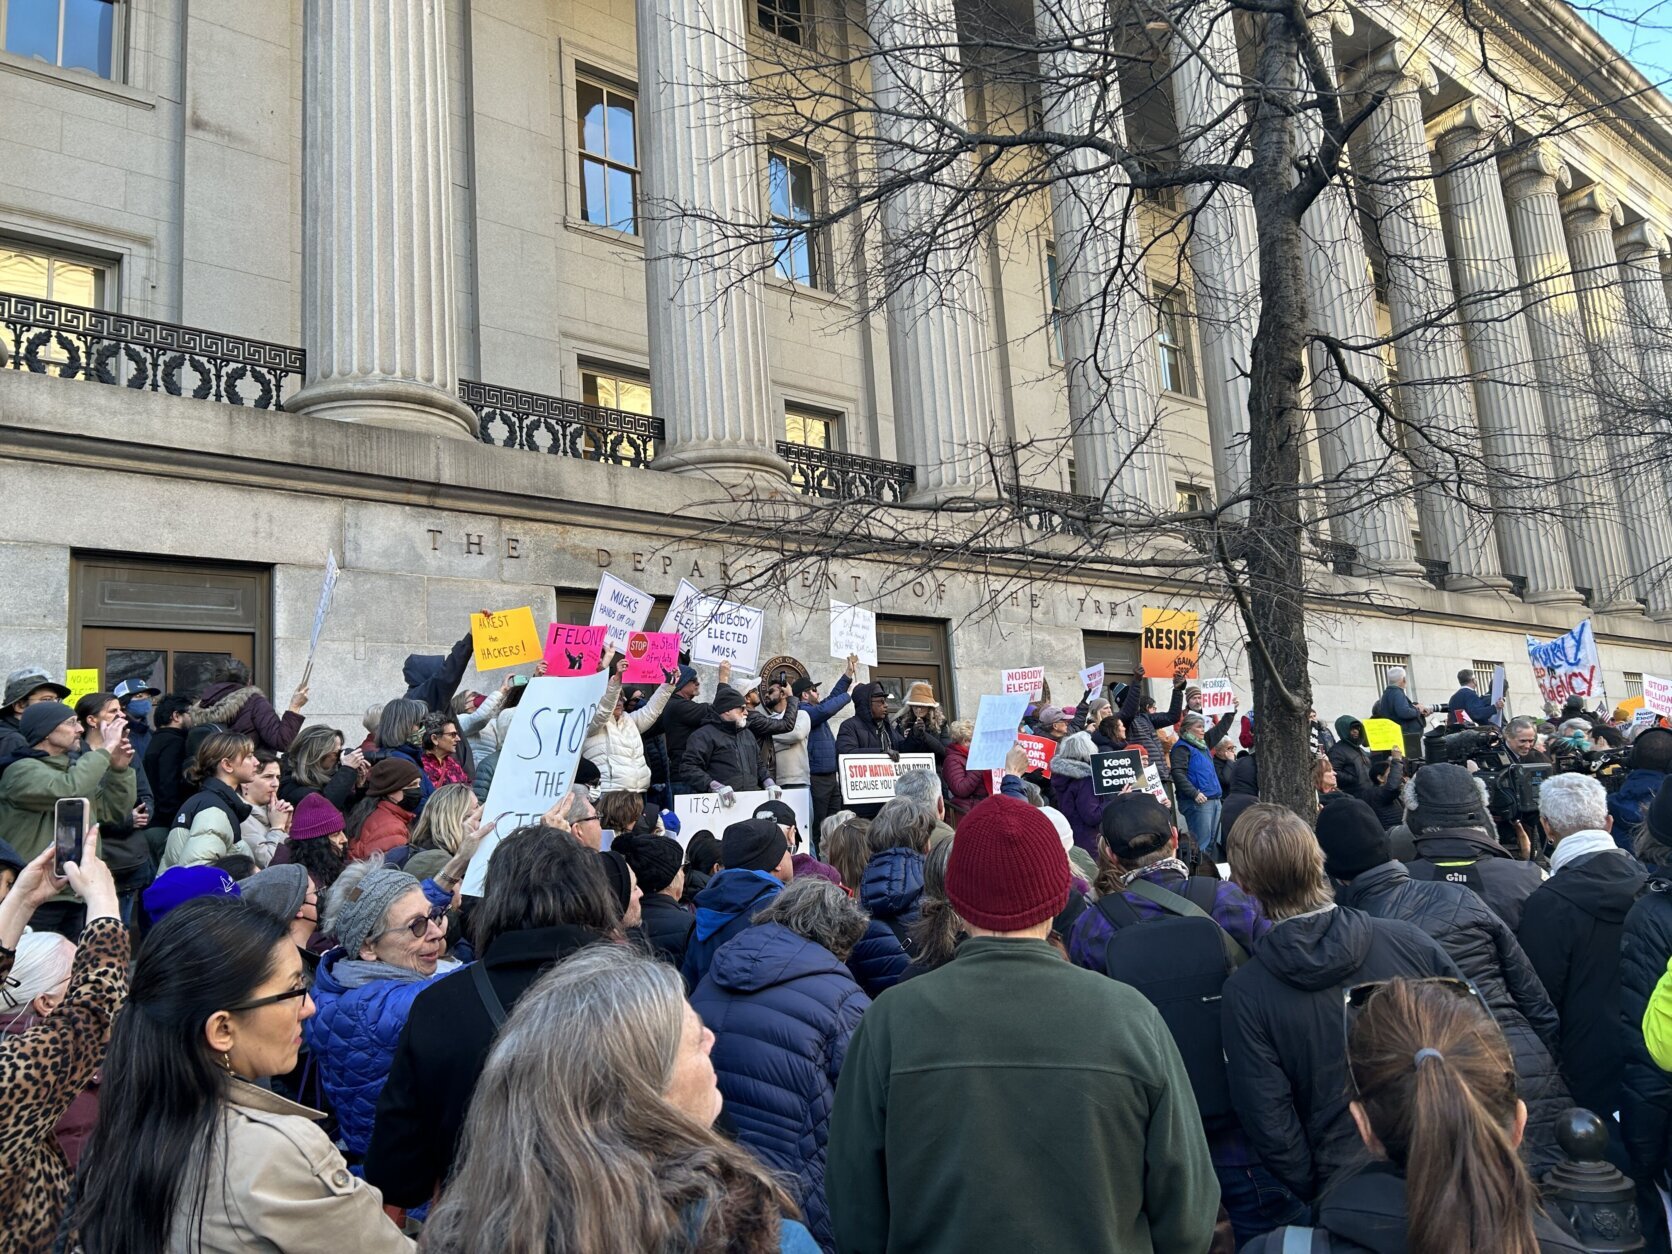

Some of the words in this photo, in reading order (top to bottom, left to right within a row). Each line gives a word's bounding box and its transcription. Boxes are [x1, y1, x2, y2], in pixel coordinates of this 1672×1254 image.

[426, 529, 521, 559] THE
[912, 581, 946, 600] OF
[990, 589, 1040, 609] THE
[610, 590, 639, 613] MUSK'S
[599, 603, 616, 619] HANDS
[479, 615, 509, 629] ARREST
[710, 612, 751, 629] NOBODY
[553, 627, 605, 646] FELON!
[707, 628, 748, 644] ELECTED
[1144, 627, 1195, 652] RESIST
[481, 640, 527, 660] HACKERS!
[630, 640, 647, 651] STOP
[711, 645, 737, 659] MUSK
[1007, 670, 1041, 681] NOBODY
[1006, 681, 1042, 693] ELECTED
[1648, 681, 1669, 692] STOP
[1202, 692, 1232, 708] FIGHT
[1648, 700, 1672, 715] TAKEO
[1022, 741, 1044, 750] STOP
[1103, 758, 1132, 768] Keep
[849, 765, 868, 779] STOP
[869, 764, 895, 778] HATING
[894, 764, 912, 776] EACH
[1102, 767, 1135, 777] Going,
[534, 771, 566, 798] THE
[850, 780, 880, 791] BECAUSE
[880, 779, 892, 790] YOU
[690, 797, 710, 814] IT'S
[1446, 872, 1467, 883] Gill
